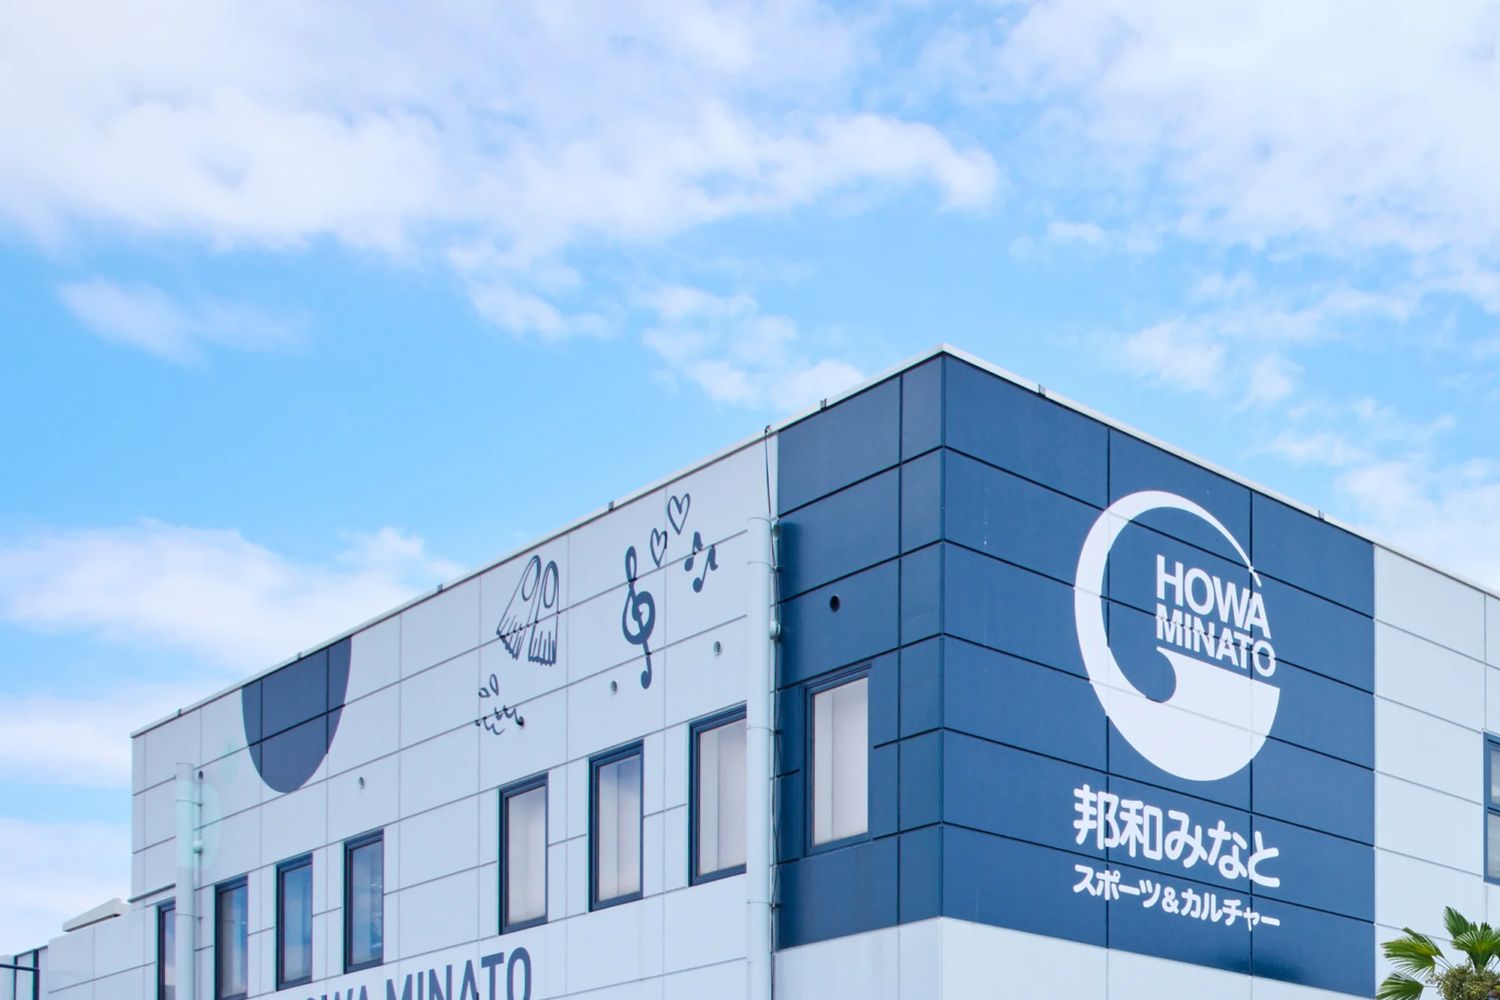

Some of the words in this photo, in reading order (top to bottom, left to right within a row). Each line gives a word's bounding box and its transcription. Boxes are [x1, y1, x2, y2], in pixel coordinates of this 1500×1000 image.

[1156, 553, 1272, 639] HOWA
[1156, 604, 1277, 678] MINATO
[1073, 784, 1280, 888] 邦和みなと
